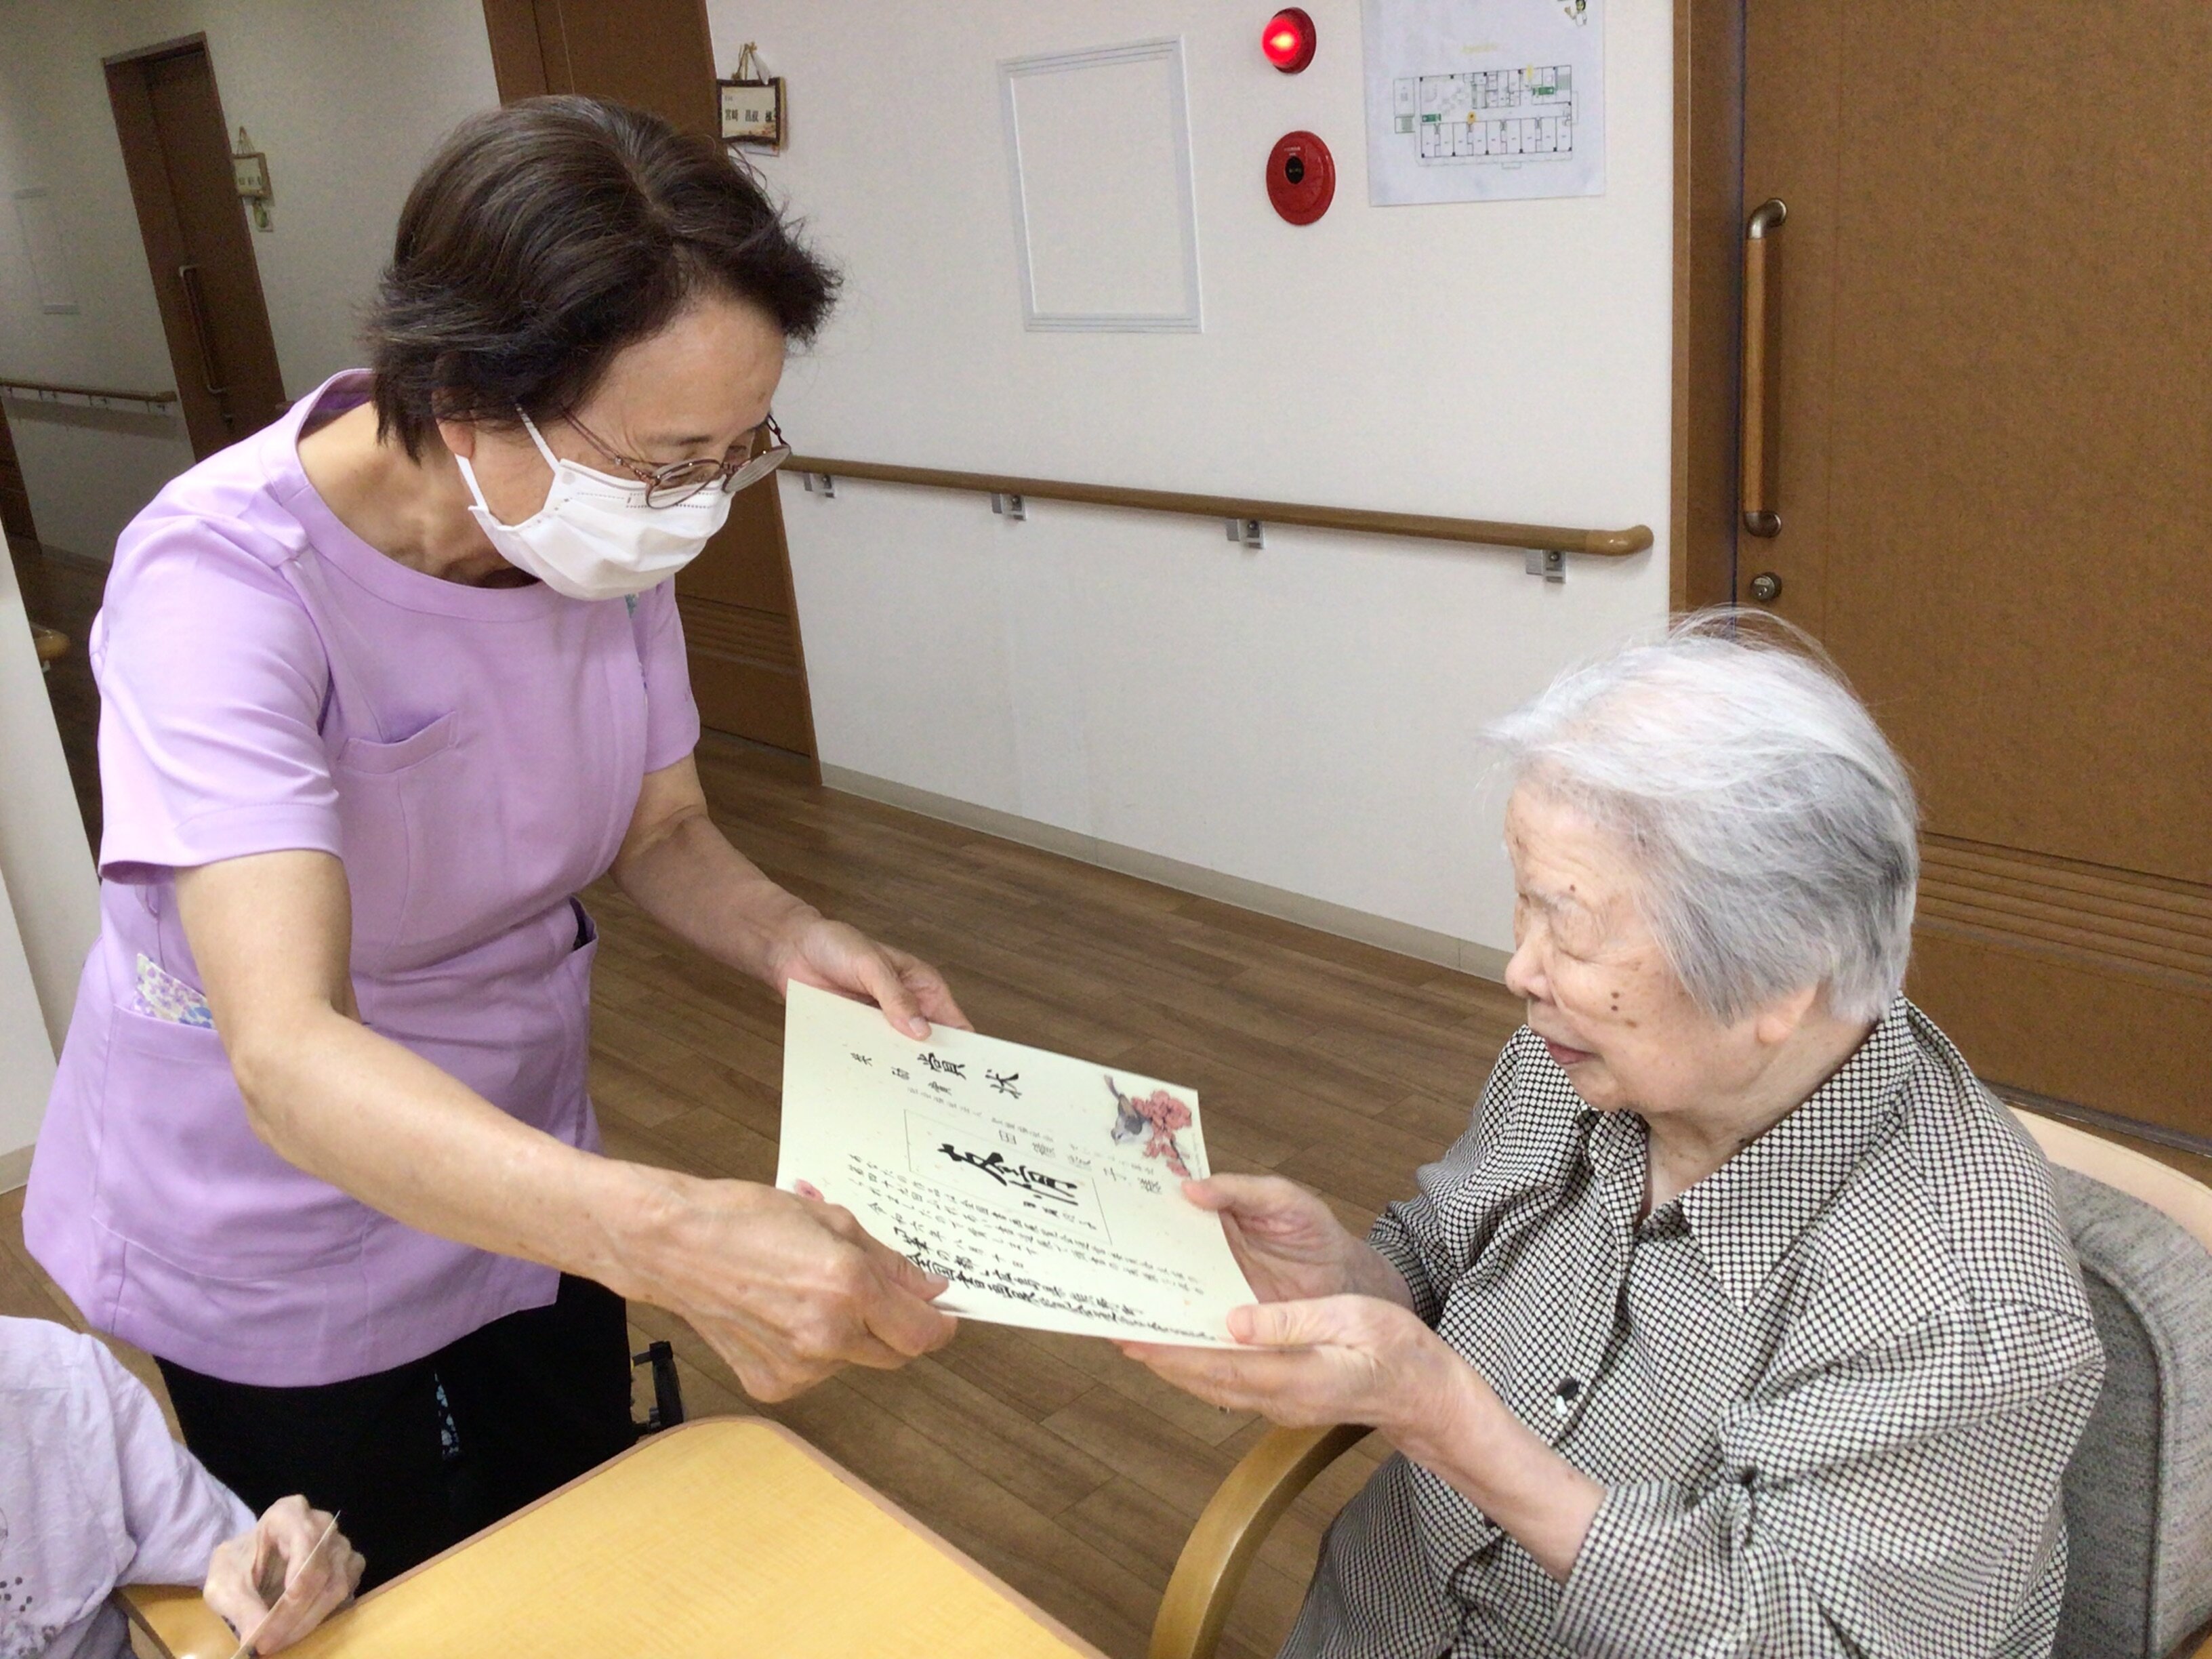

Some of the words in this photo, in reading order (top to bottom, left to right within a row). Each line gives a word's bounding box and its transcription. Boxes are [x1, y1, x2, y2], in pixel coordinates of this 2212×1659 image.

[850, 1052, 953, 1097] 奨励賞
[917, 1052, 1022, 1099] 賞状
[937, 1143, 1079, 1206] 友情
[867, 1201, 1024, 1269] 令和六年八月十日
